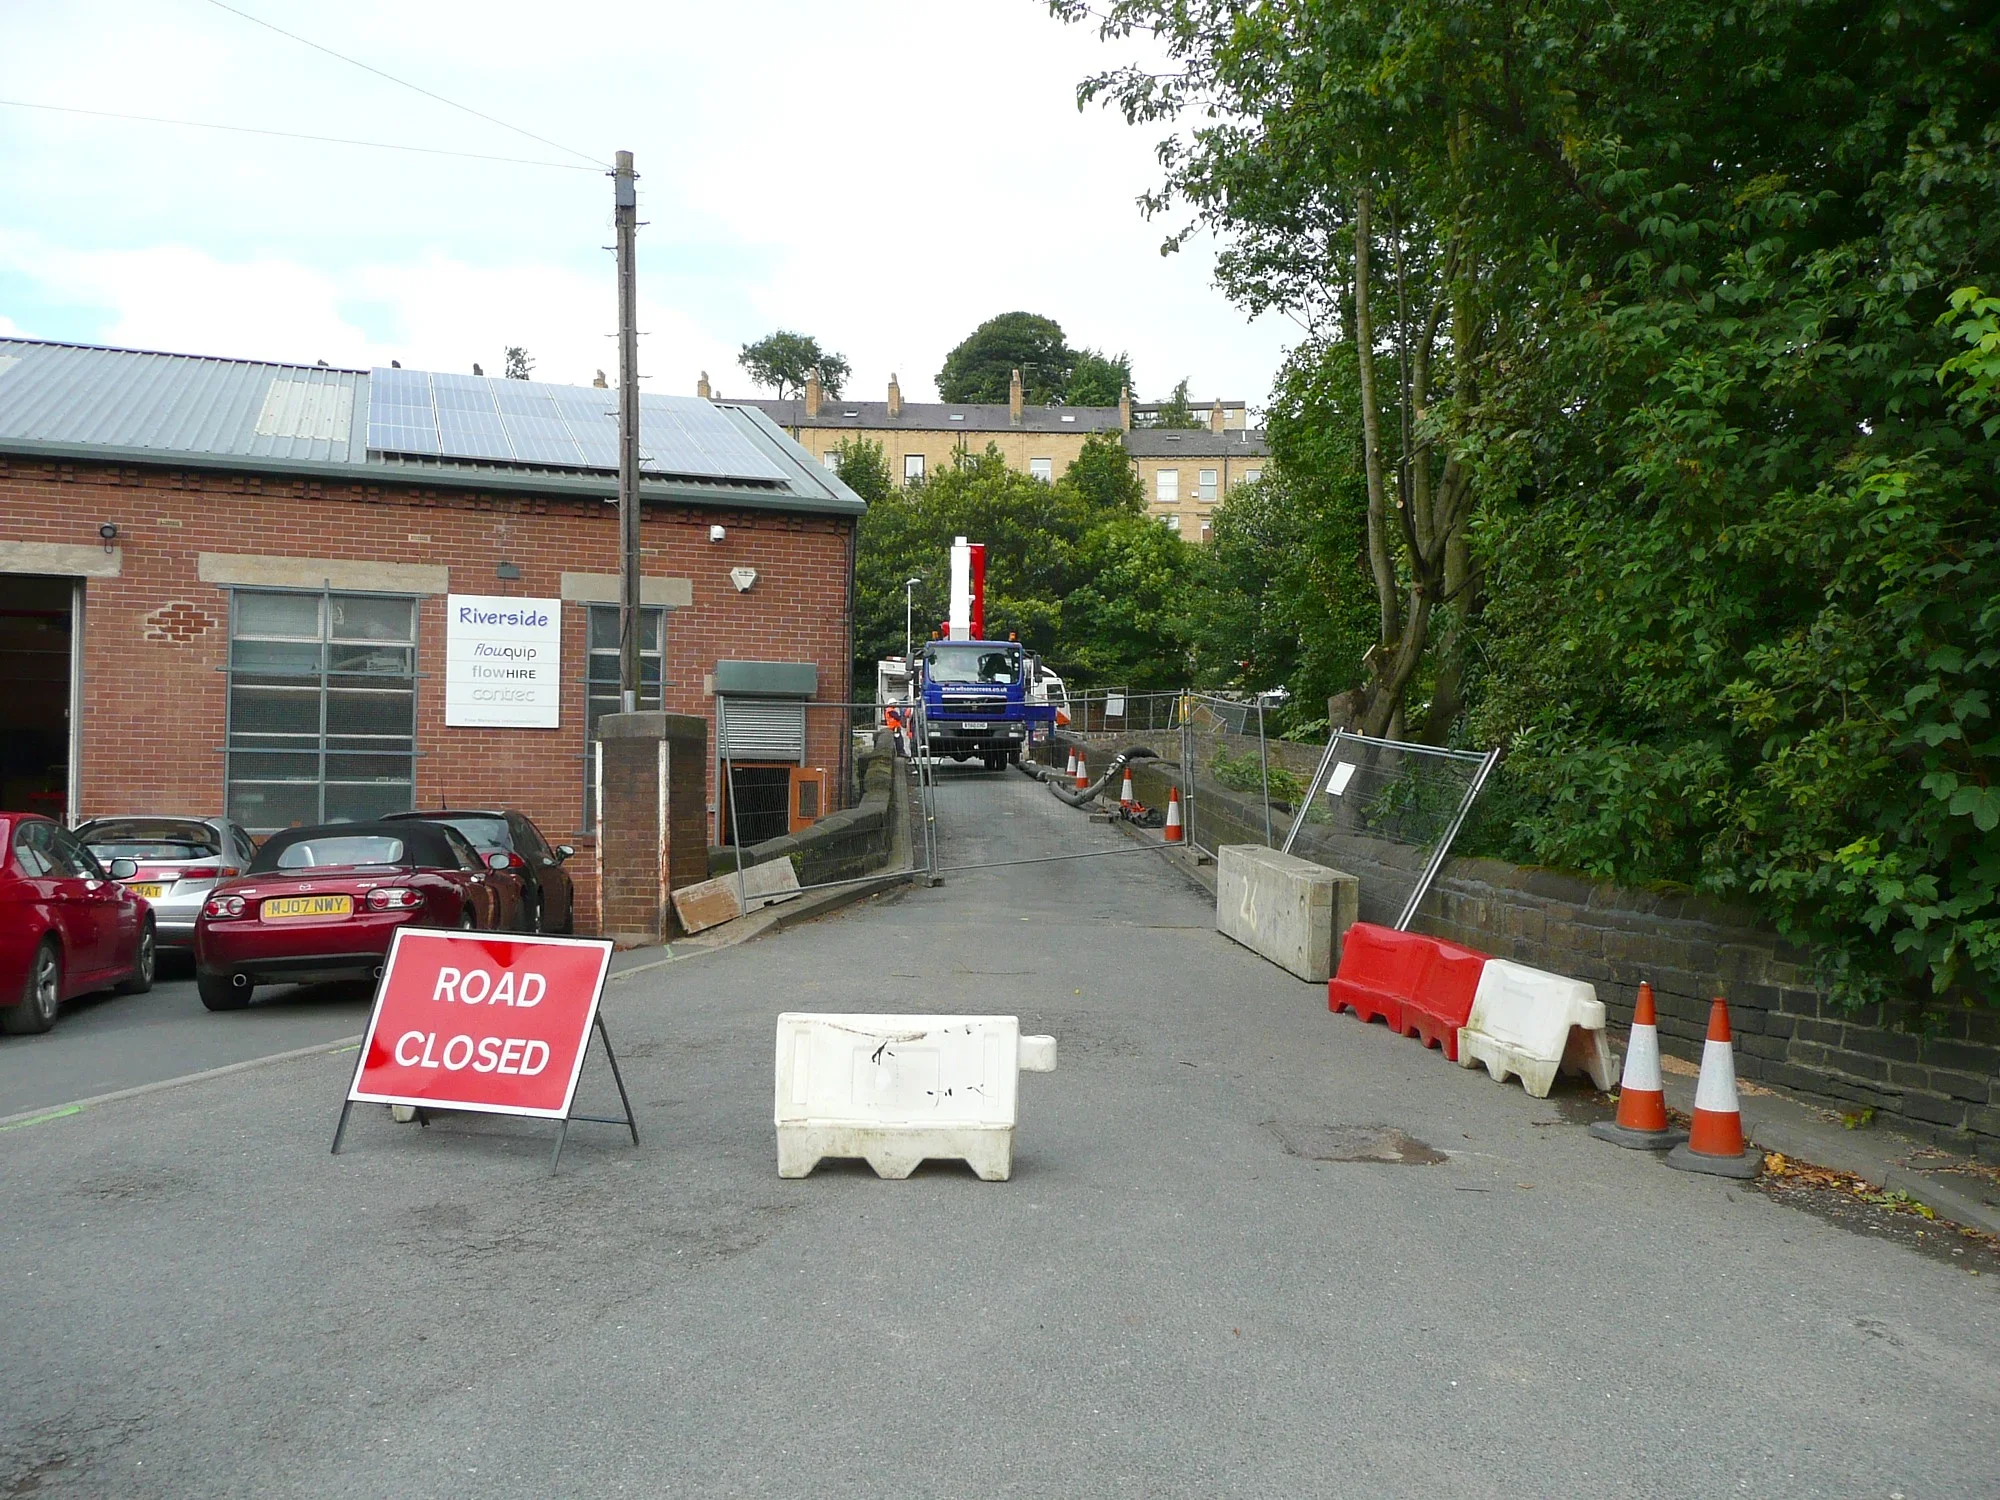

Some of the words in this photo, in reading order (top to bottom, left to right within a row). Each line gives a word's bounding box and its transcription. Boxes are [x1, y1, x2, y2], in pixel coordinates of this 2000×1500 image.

[460, 607, 548, 627] Riverside
[474, 643, 537, 661] flowquip
[472, 687, 535, 702] contrec
[271, 900, 311, 915] MJ07
[314, 898, 343, 913] NWY
[433, 967, 546, 1008] ROAD
[395, 1030, 550, 1076] CLOSED
